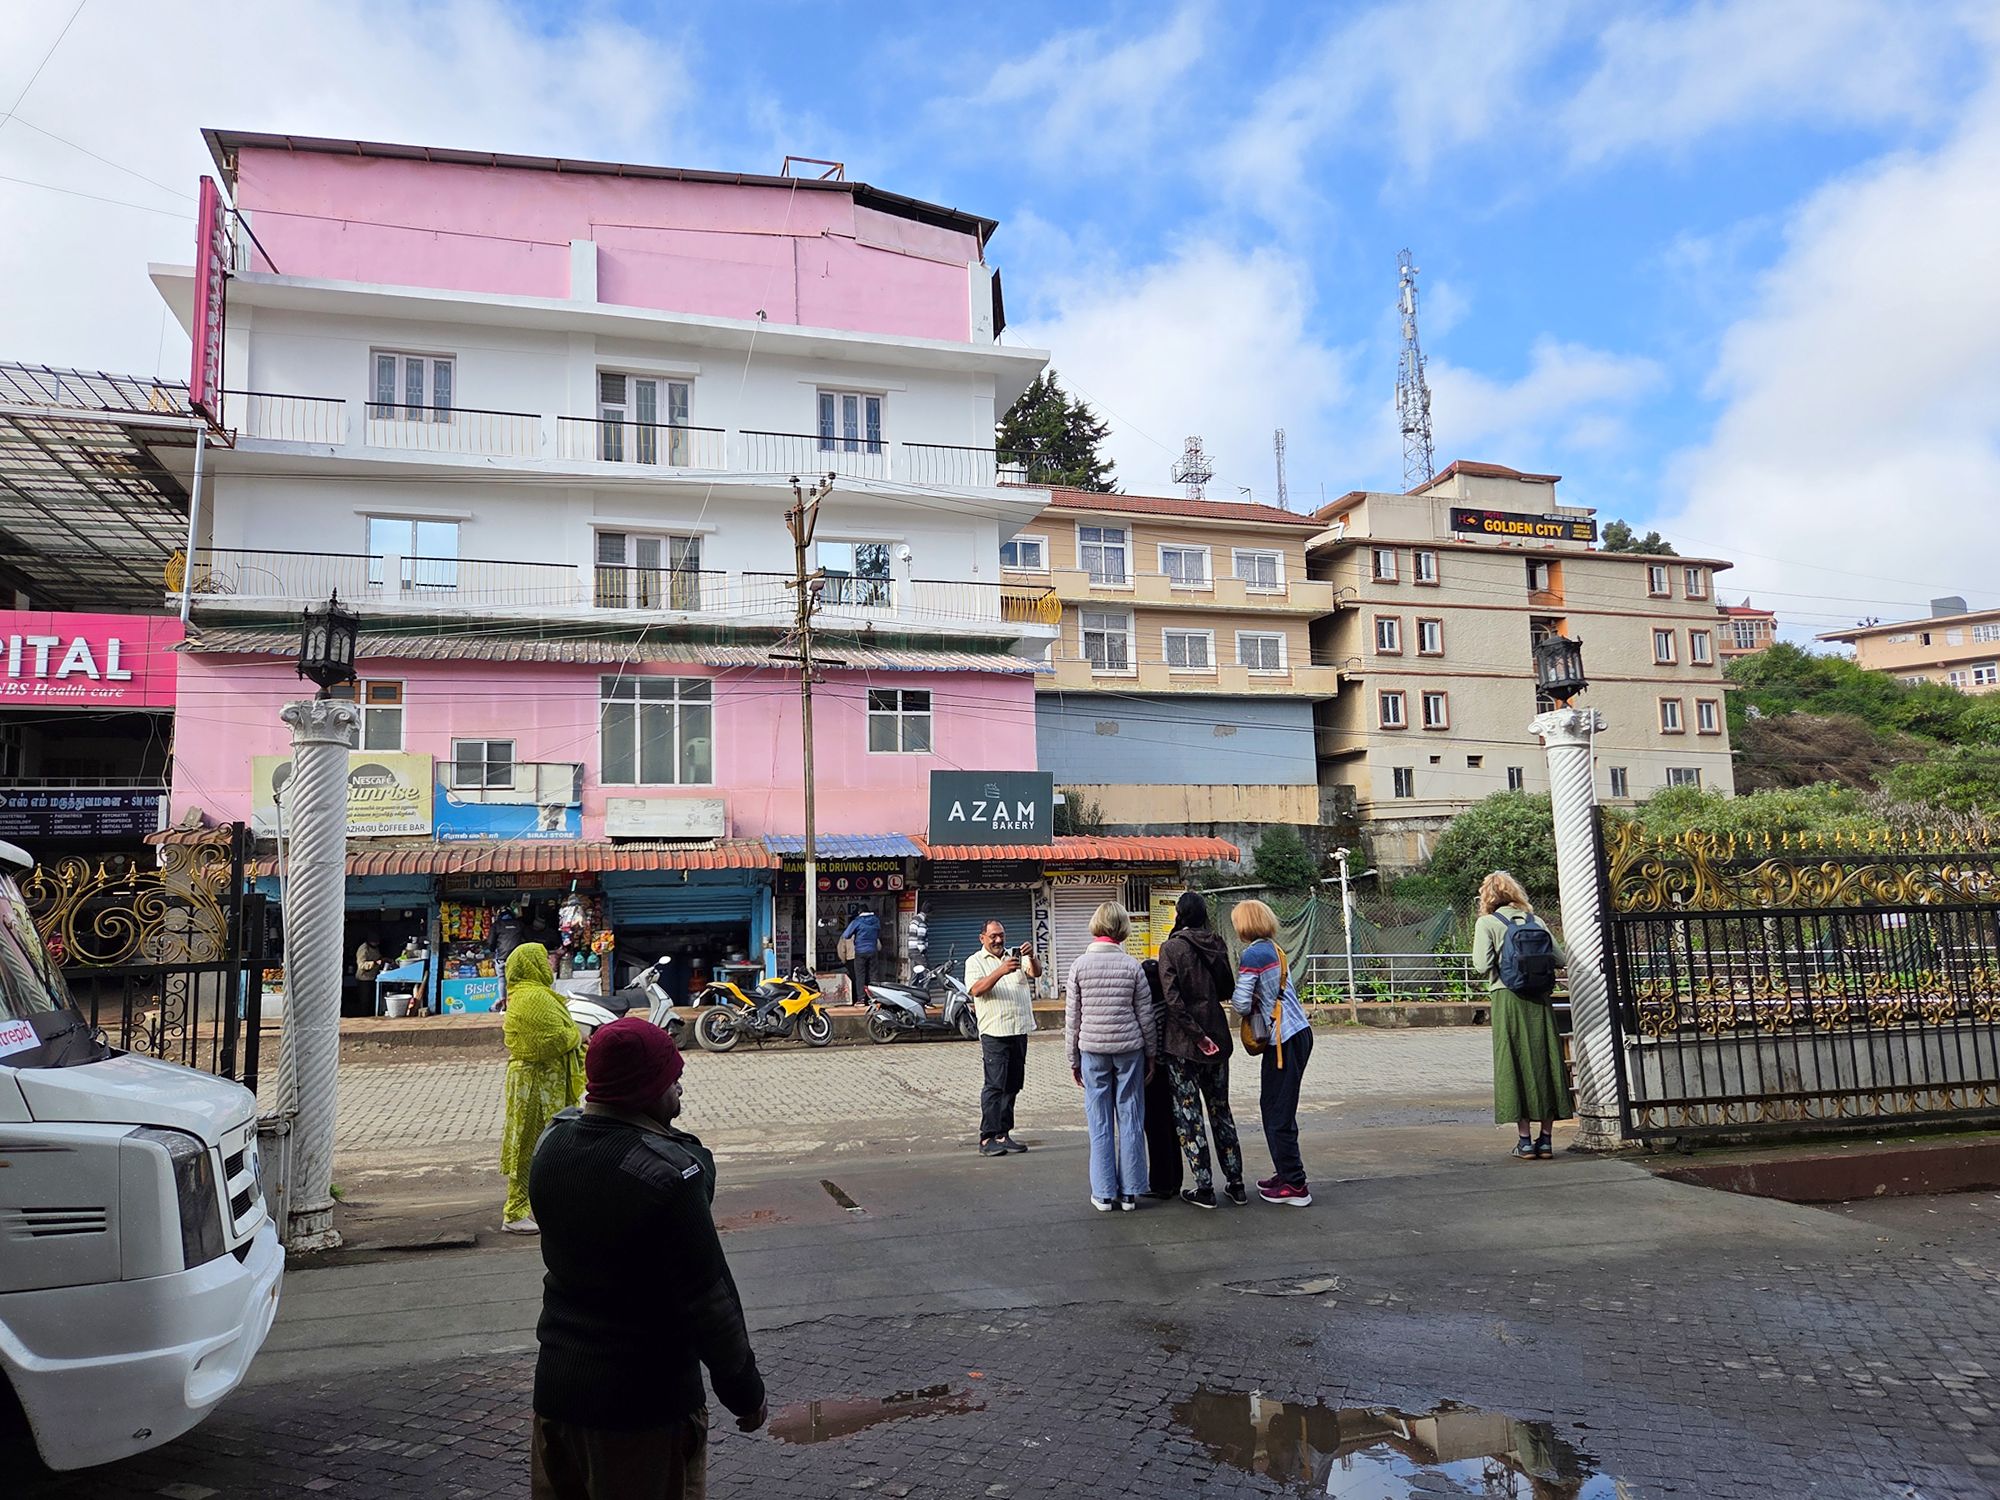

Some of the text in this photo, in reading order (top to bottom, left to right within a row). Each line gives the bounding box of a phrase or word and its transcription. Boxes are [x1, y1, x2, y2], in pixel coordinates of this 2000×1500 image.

[1484, 519, 1533, 535] GOLDEN
[1536, 523, 1563, 537] CITY
[0, 635, 132, 680] ITAL
[32, 684, 86, 697] Health
[90, 688, 125, 697] care
[947, 801, 1035, 821] AZAM
[378, 824, 408, 832] COFFEE
[409, 823, 425, 831] BAR
[992, 821, 1035, 830] BAKERY
[783, 861, 900, 873] MANAR DRIVING SCHOOL
[474, 875, 493, 889] Jio
[495, 876, 516, 888] BSNL
[1055, 874, 1126, 885] NBS TRAVELS
[464, 981, 498, 996] Bisler
